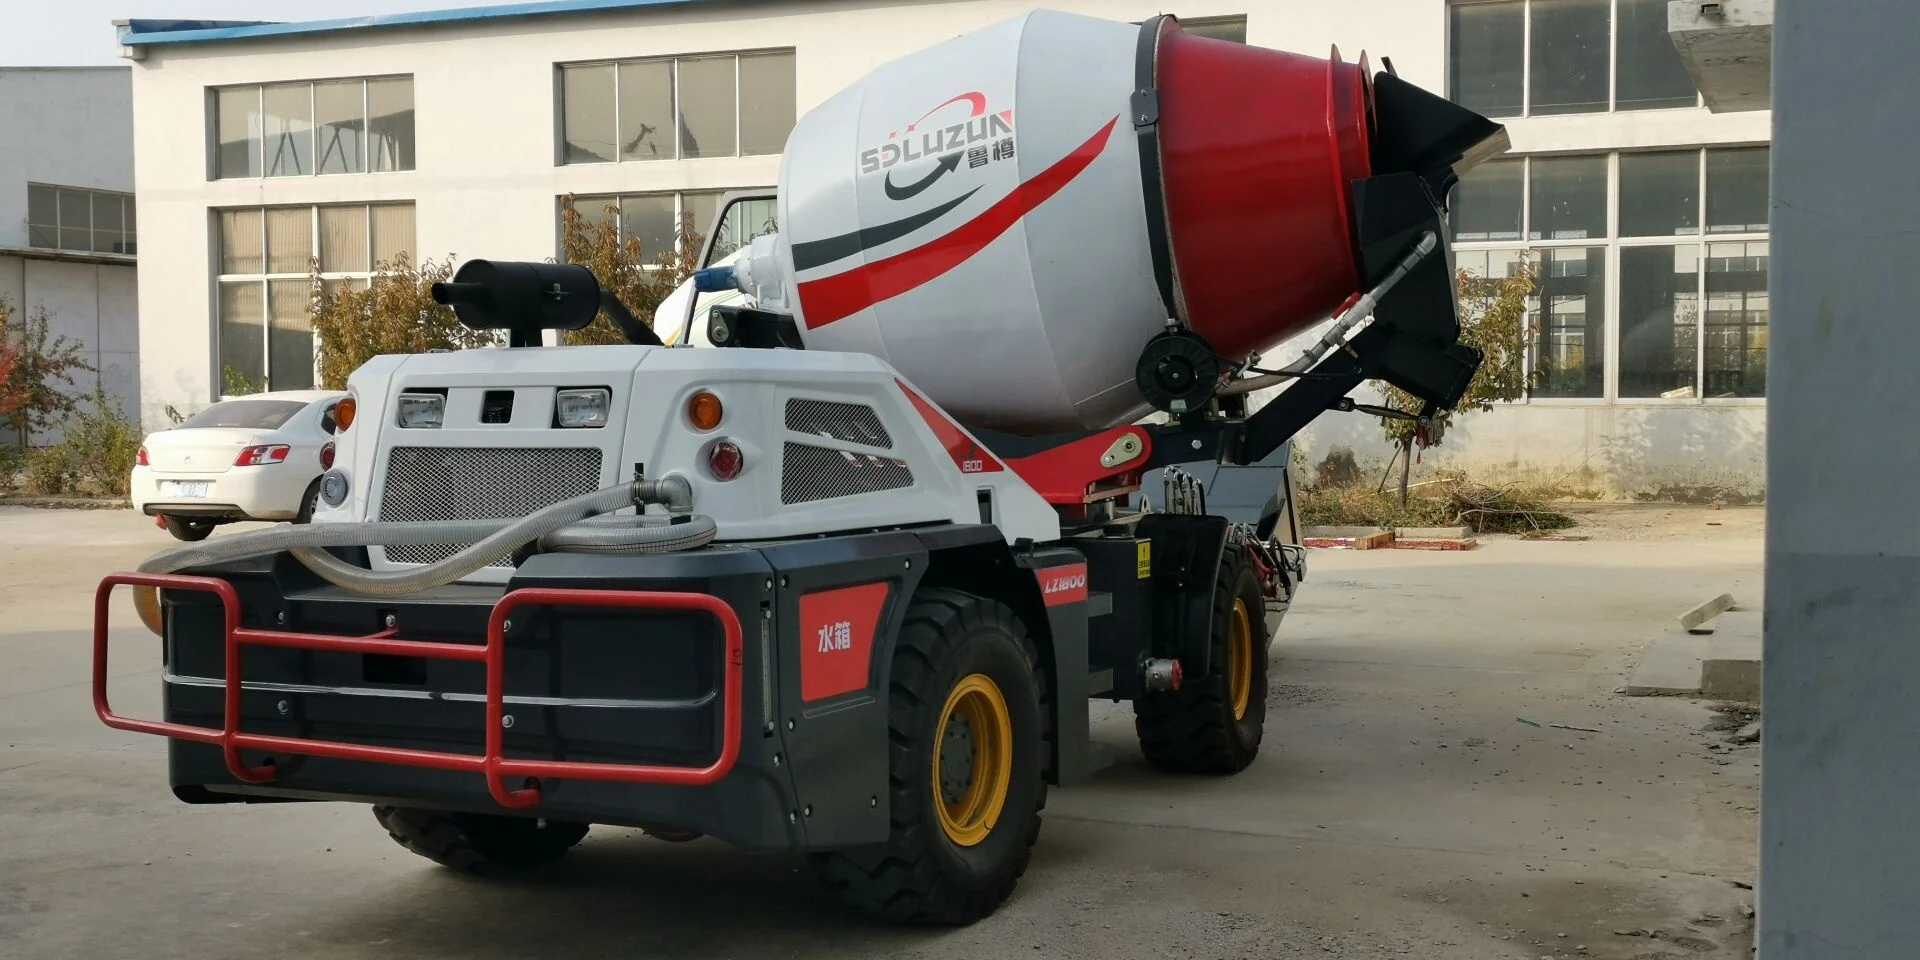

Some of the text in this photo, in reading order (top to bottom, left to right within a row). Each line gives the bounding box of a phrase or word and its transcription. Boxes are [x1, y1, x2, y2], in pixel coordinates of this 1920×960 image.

[963, 460, 982, 472] 1800
[1044, 575, 1085, 593] LZ1800
[818, 621, 851, 653] 水箱
